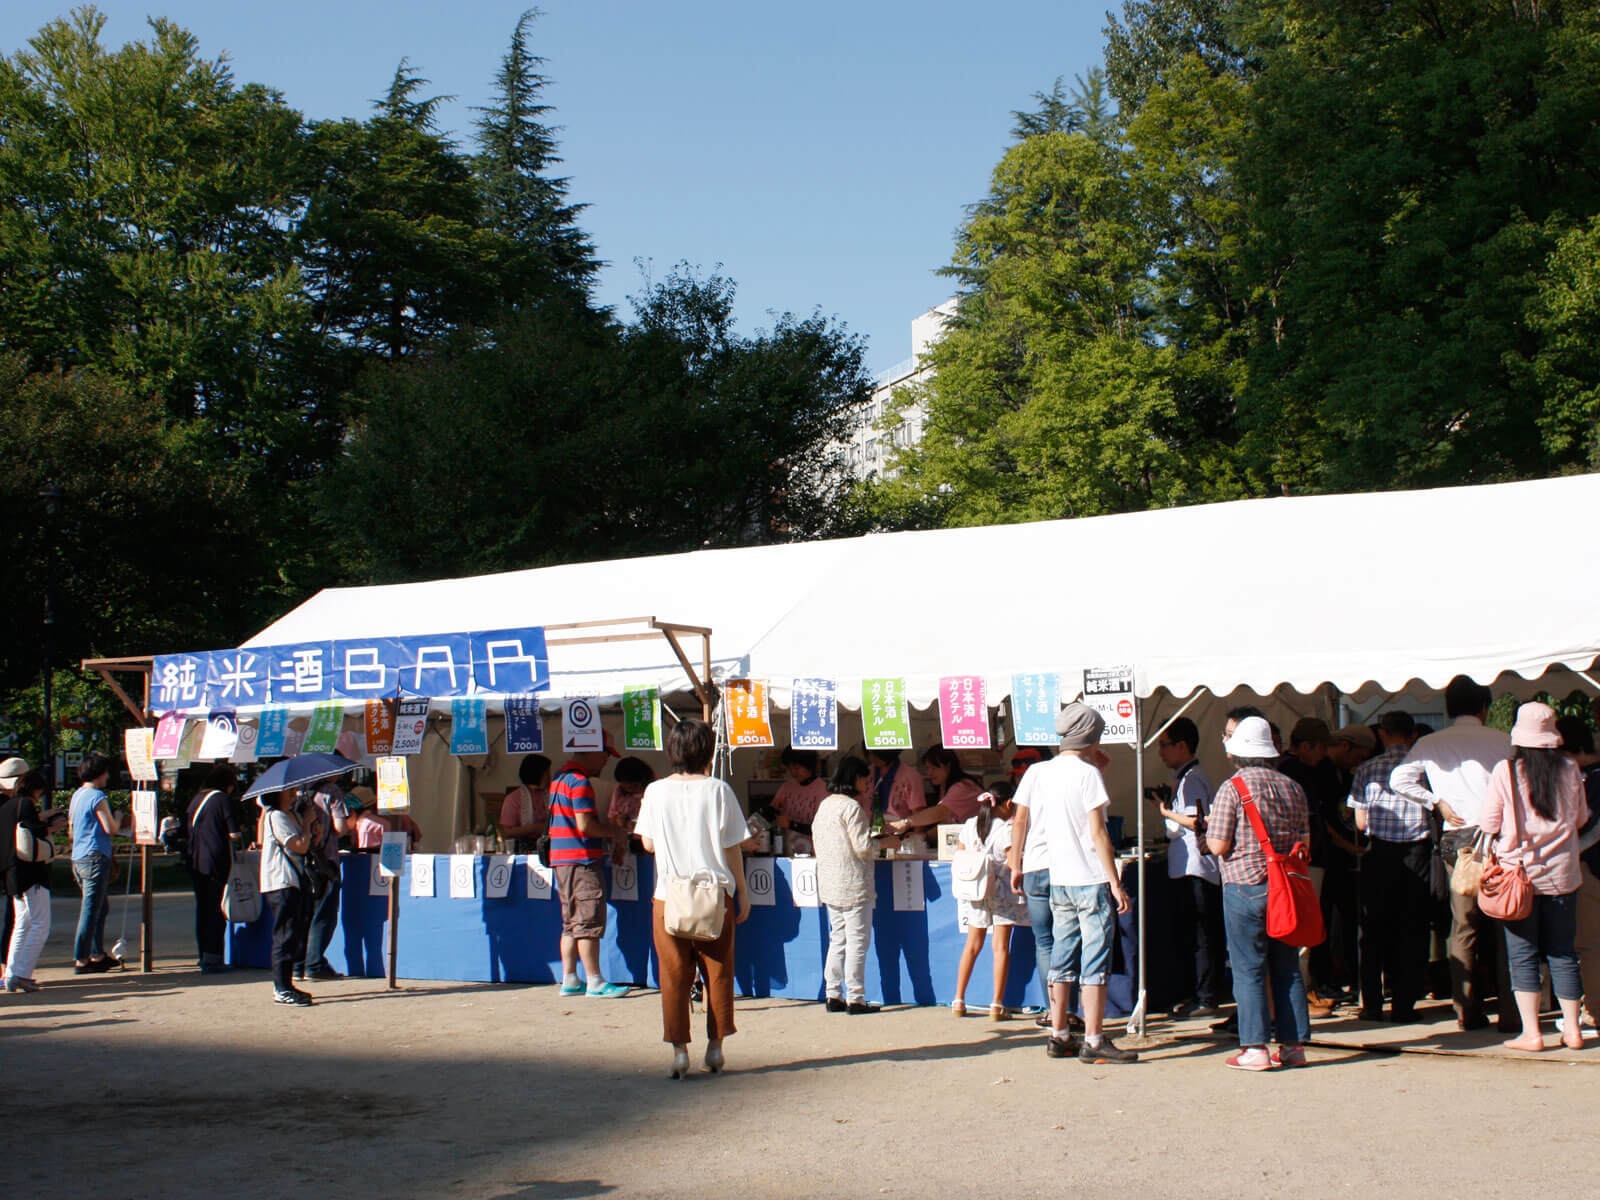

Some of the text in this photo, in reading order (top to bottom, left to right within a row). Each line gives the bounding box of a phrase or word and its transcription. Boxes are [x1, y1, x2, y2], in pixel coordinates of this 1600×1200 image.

[160, 640, 537, 702] 純米酒BAR
[883, 680, 897, 718] 日本酒
[949, 680, 962, 724] カクテル
[963, 679, 976, 717] 日本酒
[872, 681, 884, 725] カクテル
[736, 735, 769, 744] 500円
[873, 736, 905, 745] 500円
[952, 735, 984, 744] 500円
[1024, 732, 1056, 741] 500円
[456, 743, 482, 752] 500円
[512, 741, 539, 750] 700円
